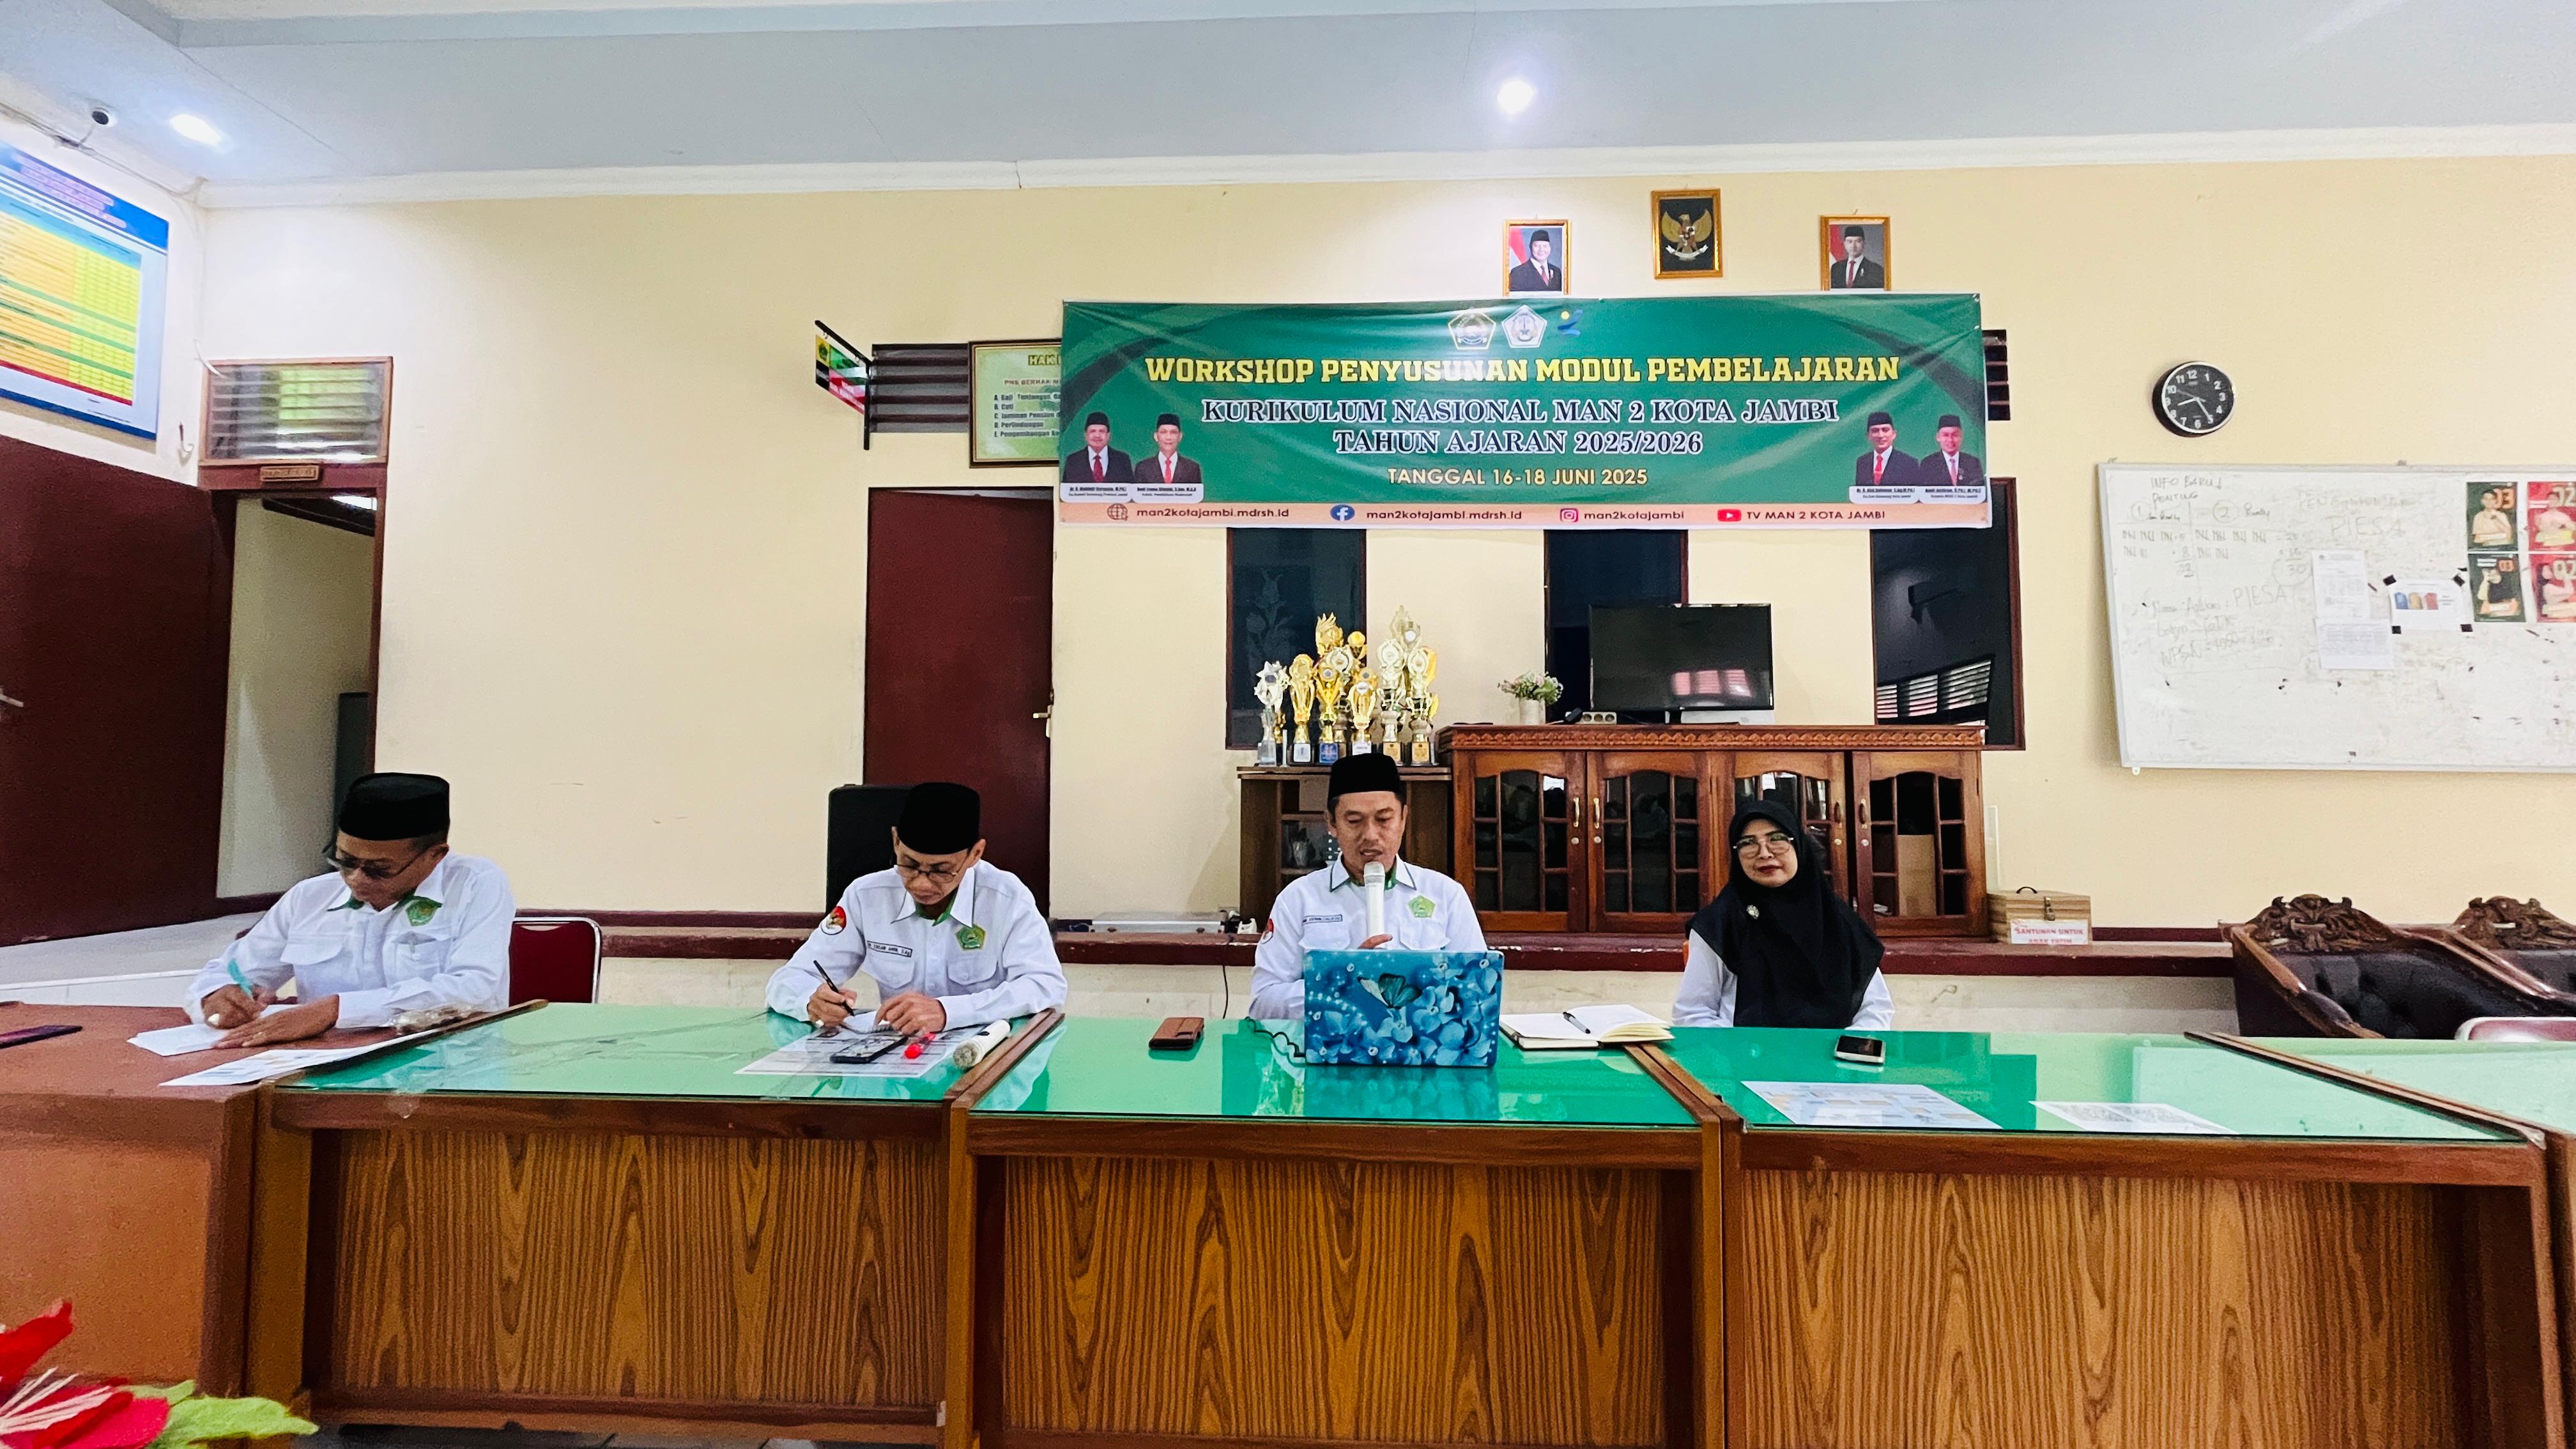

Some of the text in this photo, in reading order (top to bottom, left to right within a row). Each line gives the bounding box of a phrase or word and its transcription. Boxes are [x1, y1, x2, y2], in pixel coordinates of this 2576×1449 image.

[1027, 354, 1055, 366] HAK
[1145, 356, 1901, 383] WORKSHOP PENYUSUNAN MODUL PEMBELAJARAN
[2187, 369, 2198, 379] 12
[2175, 375, 2185, 384] 11
[2204, 372, 2210, 381] 1
[2166, 385, 2177, 394] 10
[2214, 380, 2221, 390] 2
[2219, 392, 2226, 401] 3
[1202, 399, 1839, 424] KURIKULUM NASIONAL MAN 2 KOTA JAMBI
[2216, 405, 2223, 414] 4
[2181, 417, 2188, 426] 7
[2194, 419, 2202, 429] 6
[2207, 415, 2214, 424] 5
[1333, 430, 1704, 455] TAHUN AJARAN 2025/2026
[1388, 468, 1648, 485] TANGGAL 16-18 JUNI 2025
[1136, 507, 1289, 520] man2kotajambi.mdrsh.id
[1366, 510, 1522, 521] man2kotajambi.mdrsh.id
[1583, 510, 1685, 521] man2kotajambi
[1746, 511, 1885, 520] TV MAN 2 KOTA JAMBI
[2323, 514, 2406, 539] PIESA
[2232, 583, 2287, 611] PIESA
